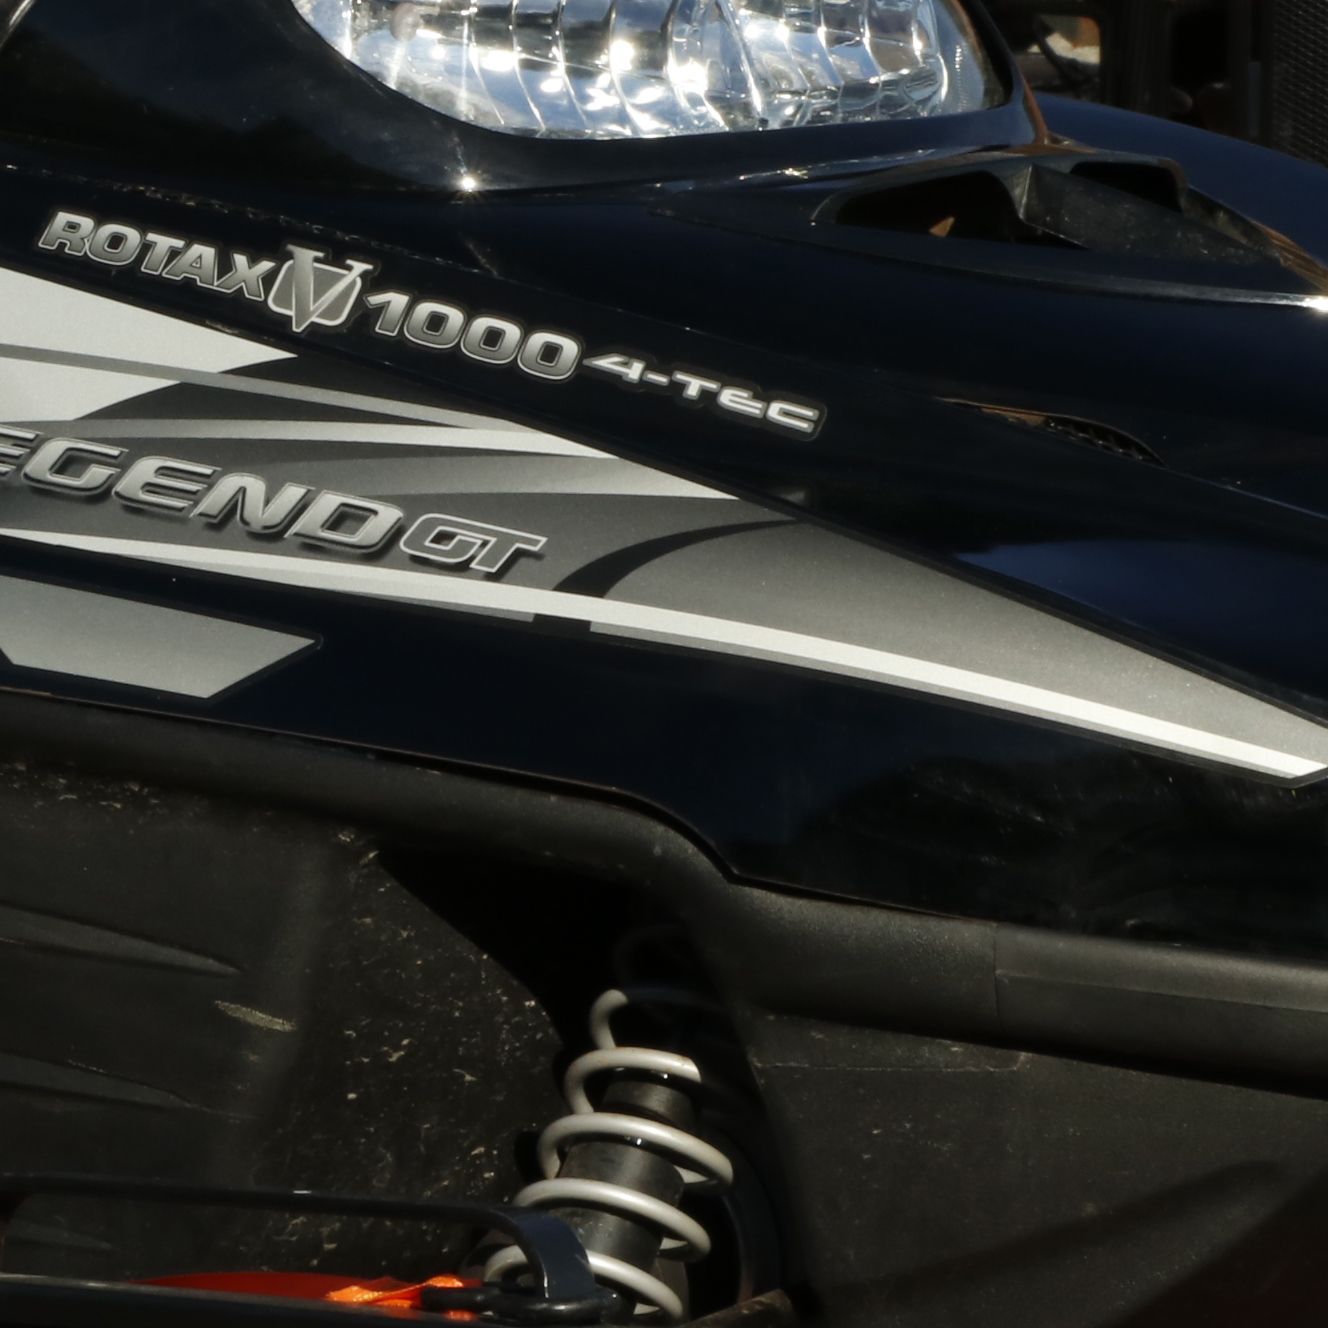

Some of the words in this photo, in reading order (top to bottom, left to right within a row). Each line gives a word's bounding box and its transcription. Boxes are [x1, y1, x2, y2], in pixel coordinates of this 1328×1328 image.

[39, 210, 275, 302] ROTAX
[362, 291, 581, 381] 1000
[582, 353, 821, 434] 4-TEC
[399, 512, 548, 573] GT
